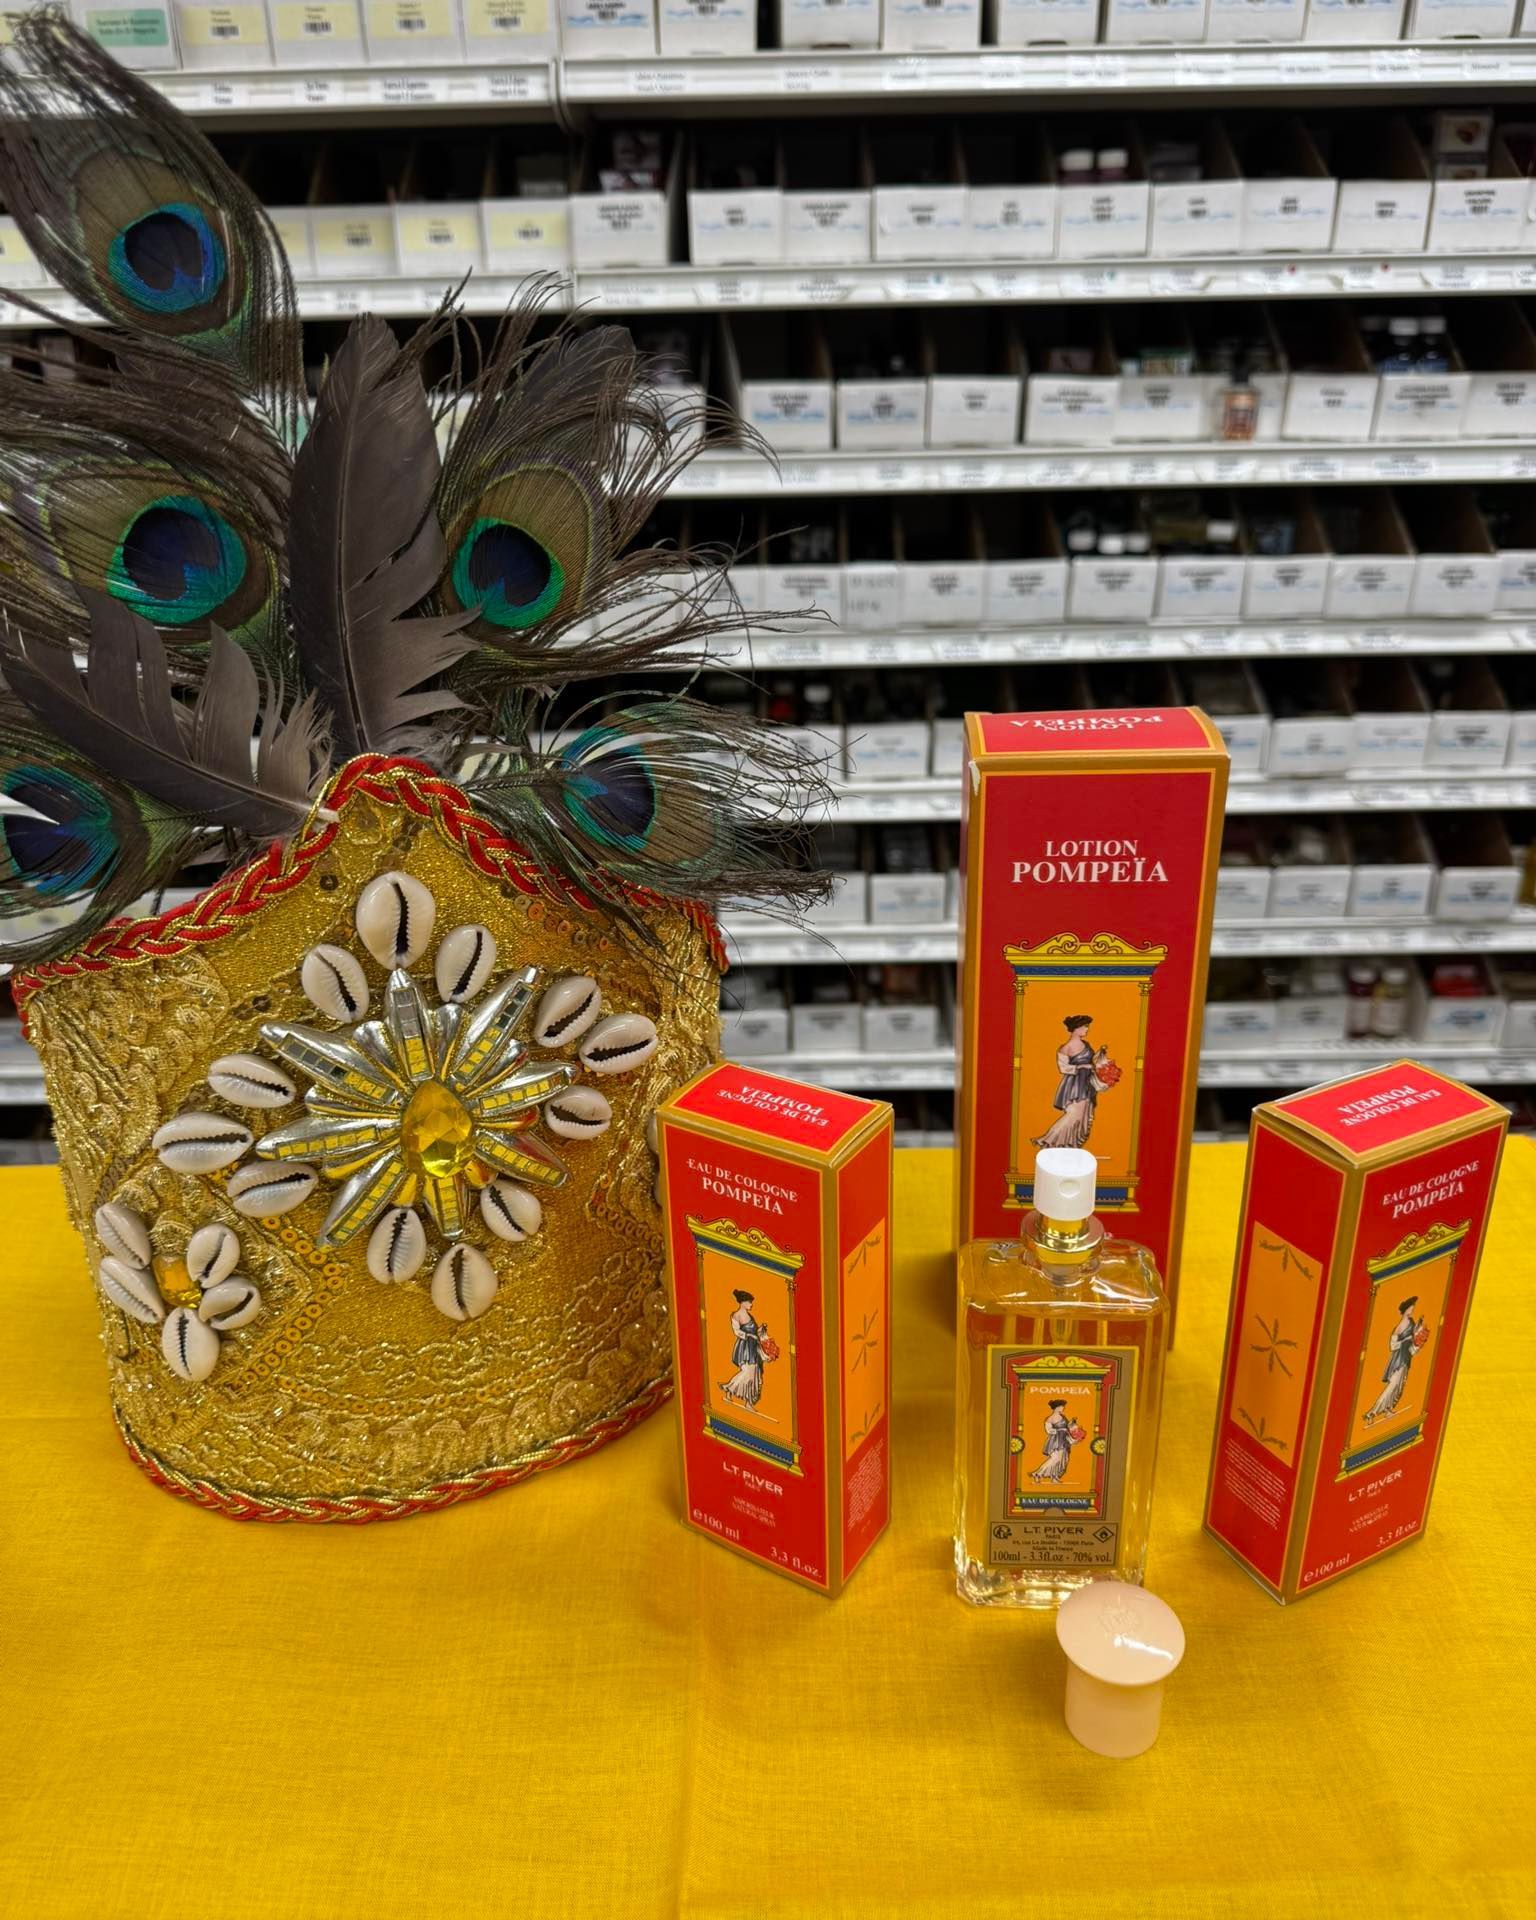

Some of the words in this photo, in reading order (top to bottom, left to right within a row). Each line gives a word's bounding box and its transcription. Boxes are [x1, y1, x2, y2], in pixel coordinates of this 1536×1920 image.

[1044, 722, 1134, 732] LOTION
[1046, 840, 1138, 857] LOTION
[1011, 857, 1168, 884] POMPEÏA
[717, 1089, 780, 1112] COLOGNE
[1399, 1097, 1417, 1108] DE
[1417, 1089, 1442, 1102] EAU
[782, 1106, 799, 1118] DE
[803, 1112, 829, 1127] EAU
[1340, 1101, 1399, 1127] COLOGNE
[686, 1158, 712, 1175] EAU
[716, 1167, 732, 1181] DE
[734, 1173, 798, 1203] COLOGNE
[1382, 1187, 1407, 1206] EAU
[1409, 1181, 1425, 1197] DE
[1426, 1160, 1479, 1189] COLOGNE
[702, 1176, 784, 1216] POMPEÏA
[1392, 1181, 1464, 1219] POMPEÏA
[743, 1470, 783, 1497] PIVER
[1366, 1469, 1402, 1493] PIVER
[725, 1527, 740, 1542] ml
[1044, 1526, 1084, 1534] PIVER
[1376, 1532, 1393, 1548] 3.3
[770, 1546, 788, 1563] 3.3
[993, 1551, 1021, 1561] 100ml
[1072, 1552, 1092, 1562] 70%
[1095, 1552, 1112, 1562] vol.
[1336, 1553, 1350, 1567] ml
